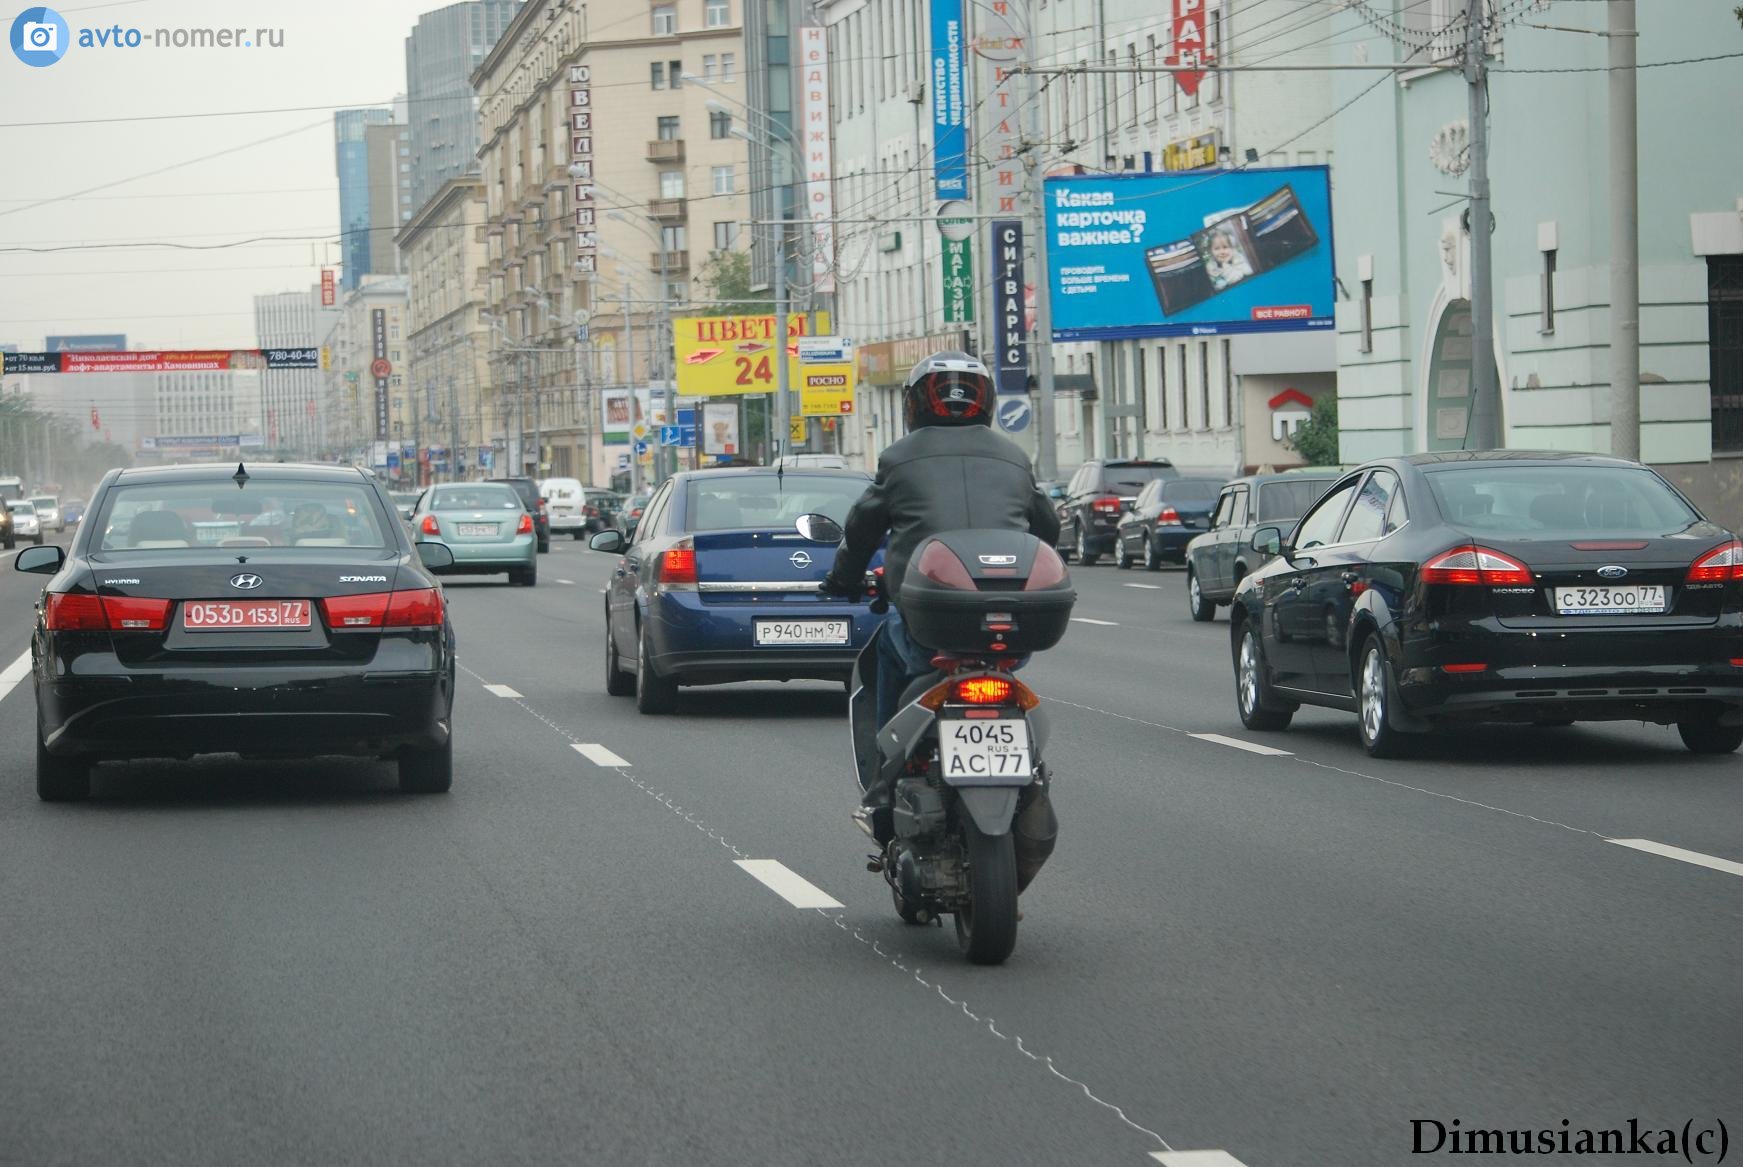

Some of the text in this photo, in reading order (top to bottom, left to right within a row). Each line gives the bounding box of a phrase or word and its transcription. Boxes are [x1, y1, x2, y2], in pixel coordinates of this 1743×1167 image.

[948, 20, 961, 126] НЕДВИЖИМОСТИ
[935, 58, 947, 125] АГЕНТСТВО
[1056, 188, 1114, 207] Какая
[1056, 209, 1146, 228] карточка
[1058, 224, 1144, 246] важнее?
[950, 242, 965, 322] МАГАЗИН
[1003, 229, 1020, 364] СИГВАРИС
[697, 315, 808, 344] ЦВЕТЫ
[269, 351, 317, 360] 780-40-40
[735, 355, 774, 386] 24
[809, 375, 844, 386] РОСНО
[1640, 586, 1657, 601] 77
[282, 602, 302, 618] 77
[827, 623, 842, 634] 97
[954, 725, 1014, 744] 4045
[994, 754, 1023, 773] 77
